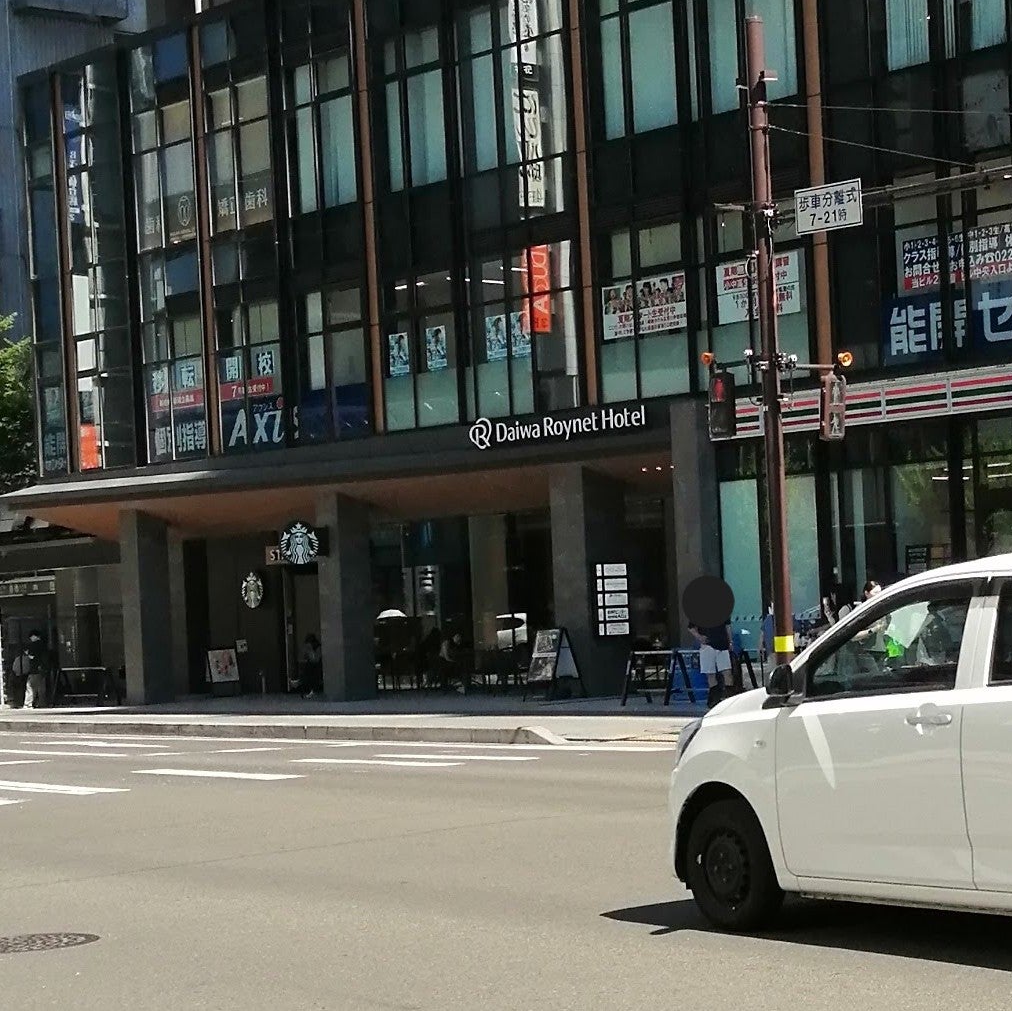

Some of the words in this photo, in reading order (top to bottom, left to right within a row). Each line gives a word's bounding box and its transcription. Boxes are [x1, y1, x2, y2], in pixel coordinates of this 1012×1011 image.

[799, 186, 857, 213] 歩車分離式
[810, 208, 847, 226] 7-21時
[496, 421, 541, 443] Daiwa
[543, 412, 599, 441] Roynet
[601, 405, 646, 430] Hotel
